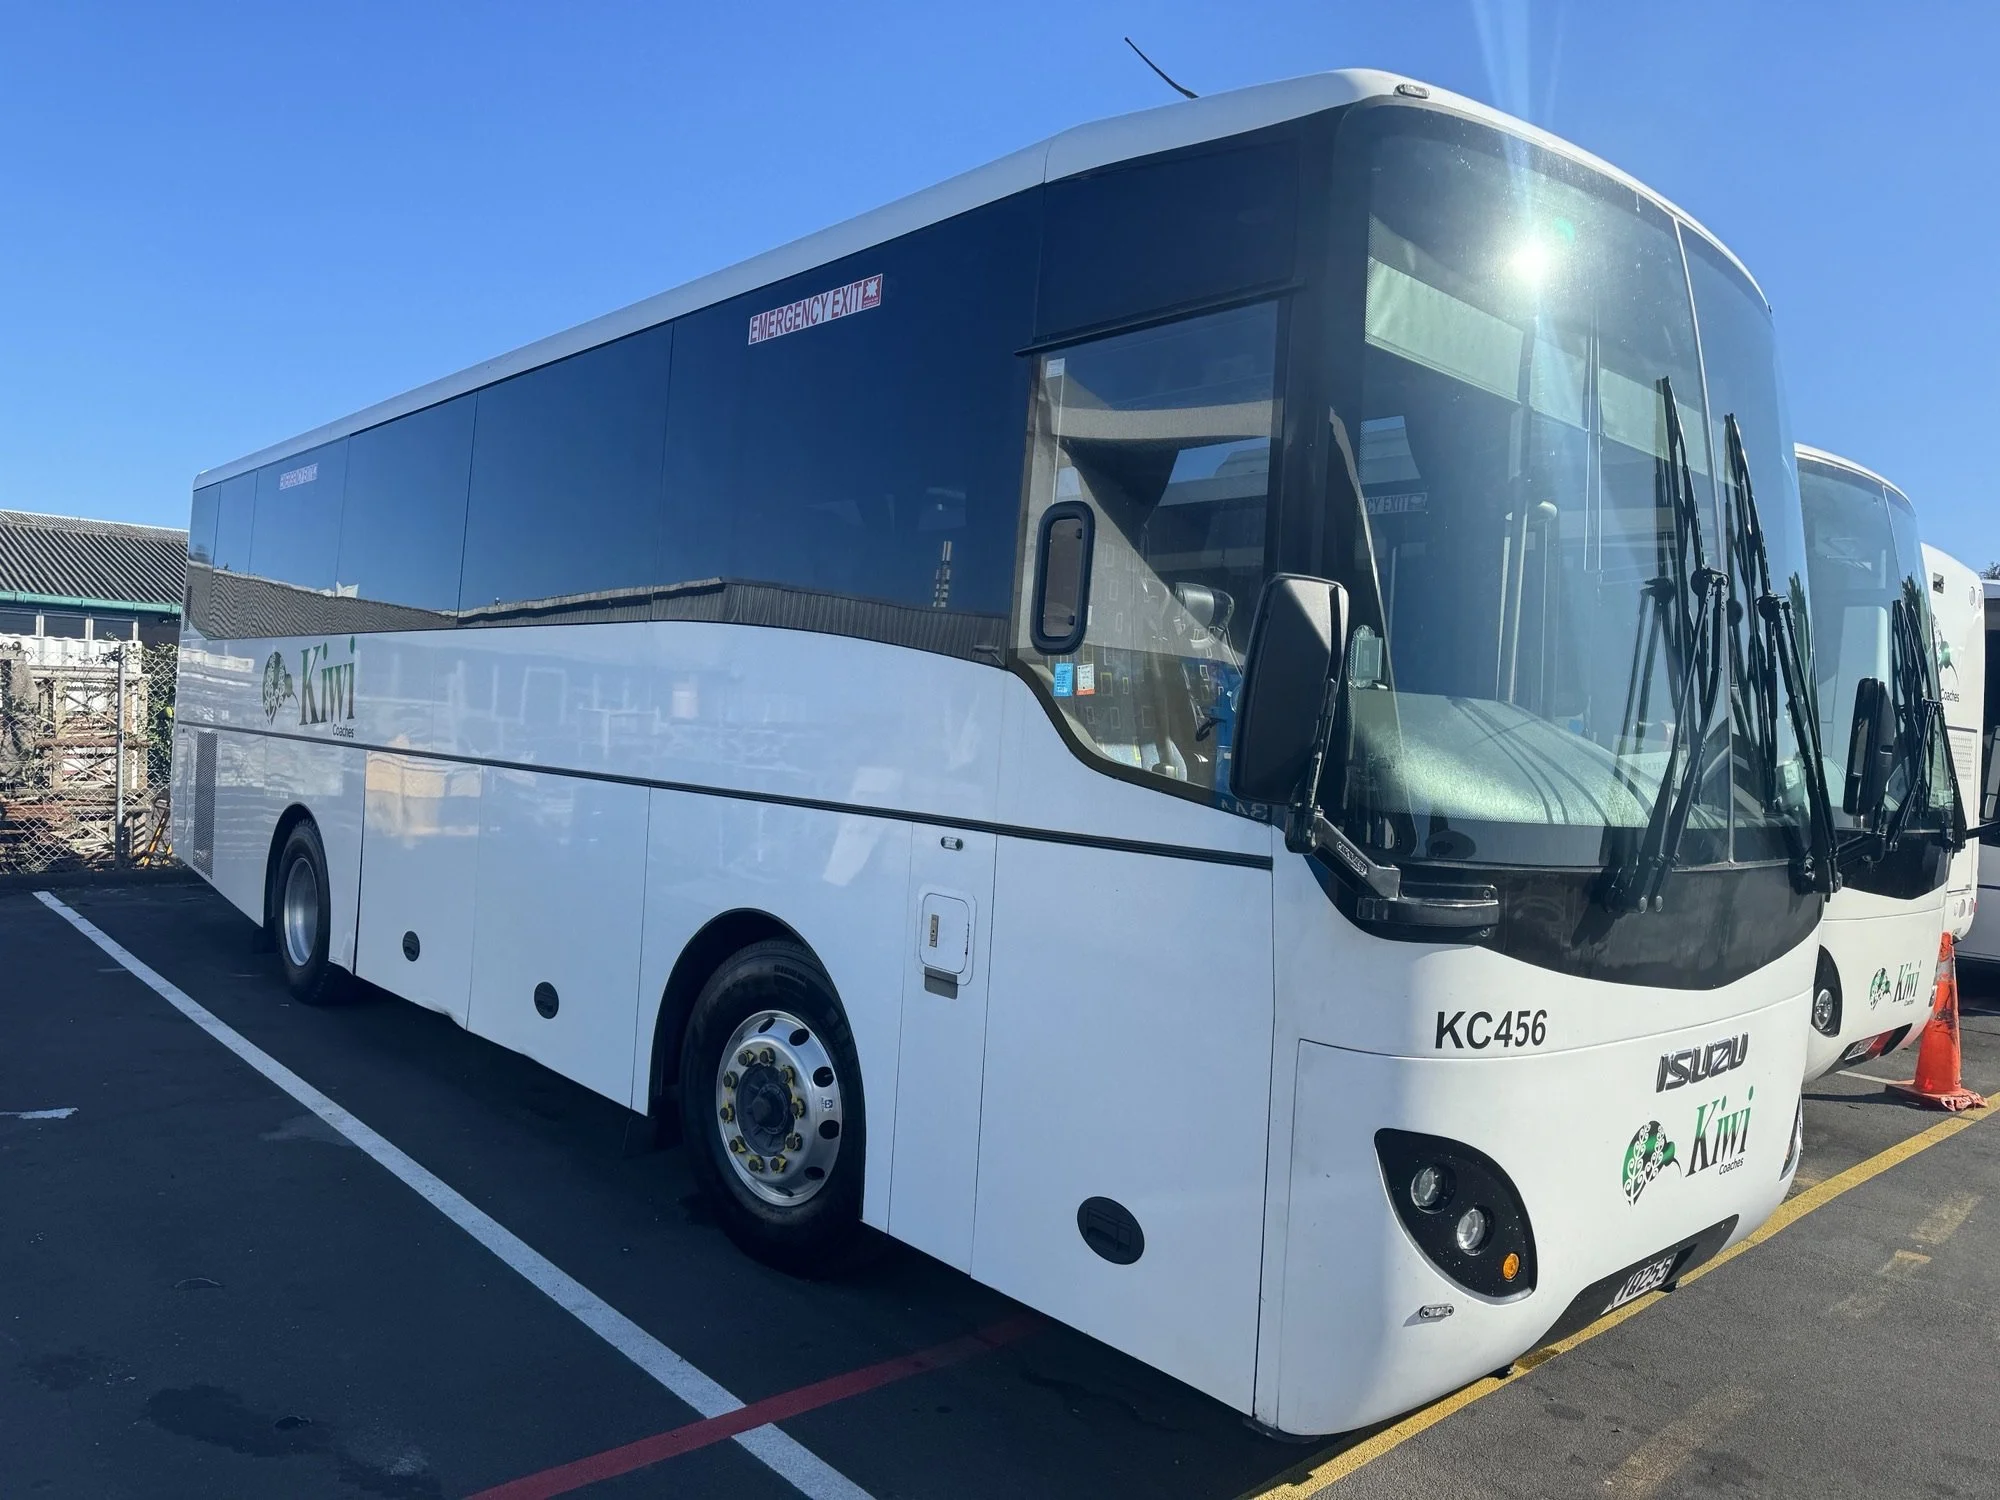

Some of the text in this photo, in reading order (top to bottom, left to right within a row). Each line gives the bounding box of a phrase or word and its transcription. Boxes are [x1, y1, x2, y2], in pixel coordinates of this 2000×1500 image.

[749, 282, 862, 343] EMERGENCY EXIT
[299, 635, 355, 725] Kiwi
[332, 723, 355, 739] Coaches
[1892, 959, 1922, 1003] Kiwi
[1435, 1009, 1548, 1050] KC456
[1656, 1031, 1749, 1093] ISUZU
[1685, 1085, 1754, 1177] Kiwi
[1719, 1157, 1744, 1175] Coaches
[1609, 1254, 1675, 1306] YQ255
